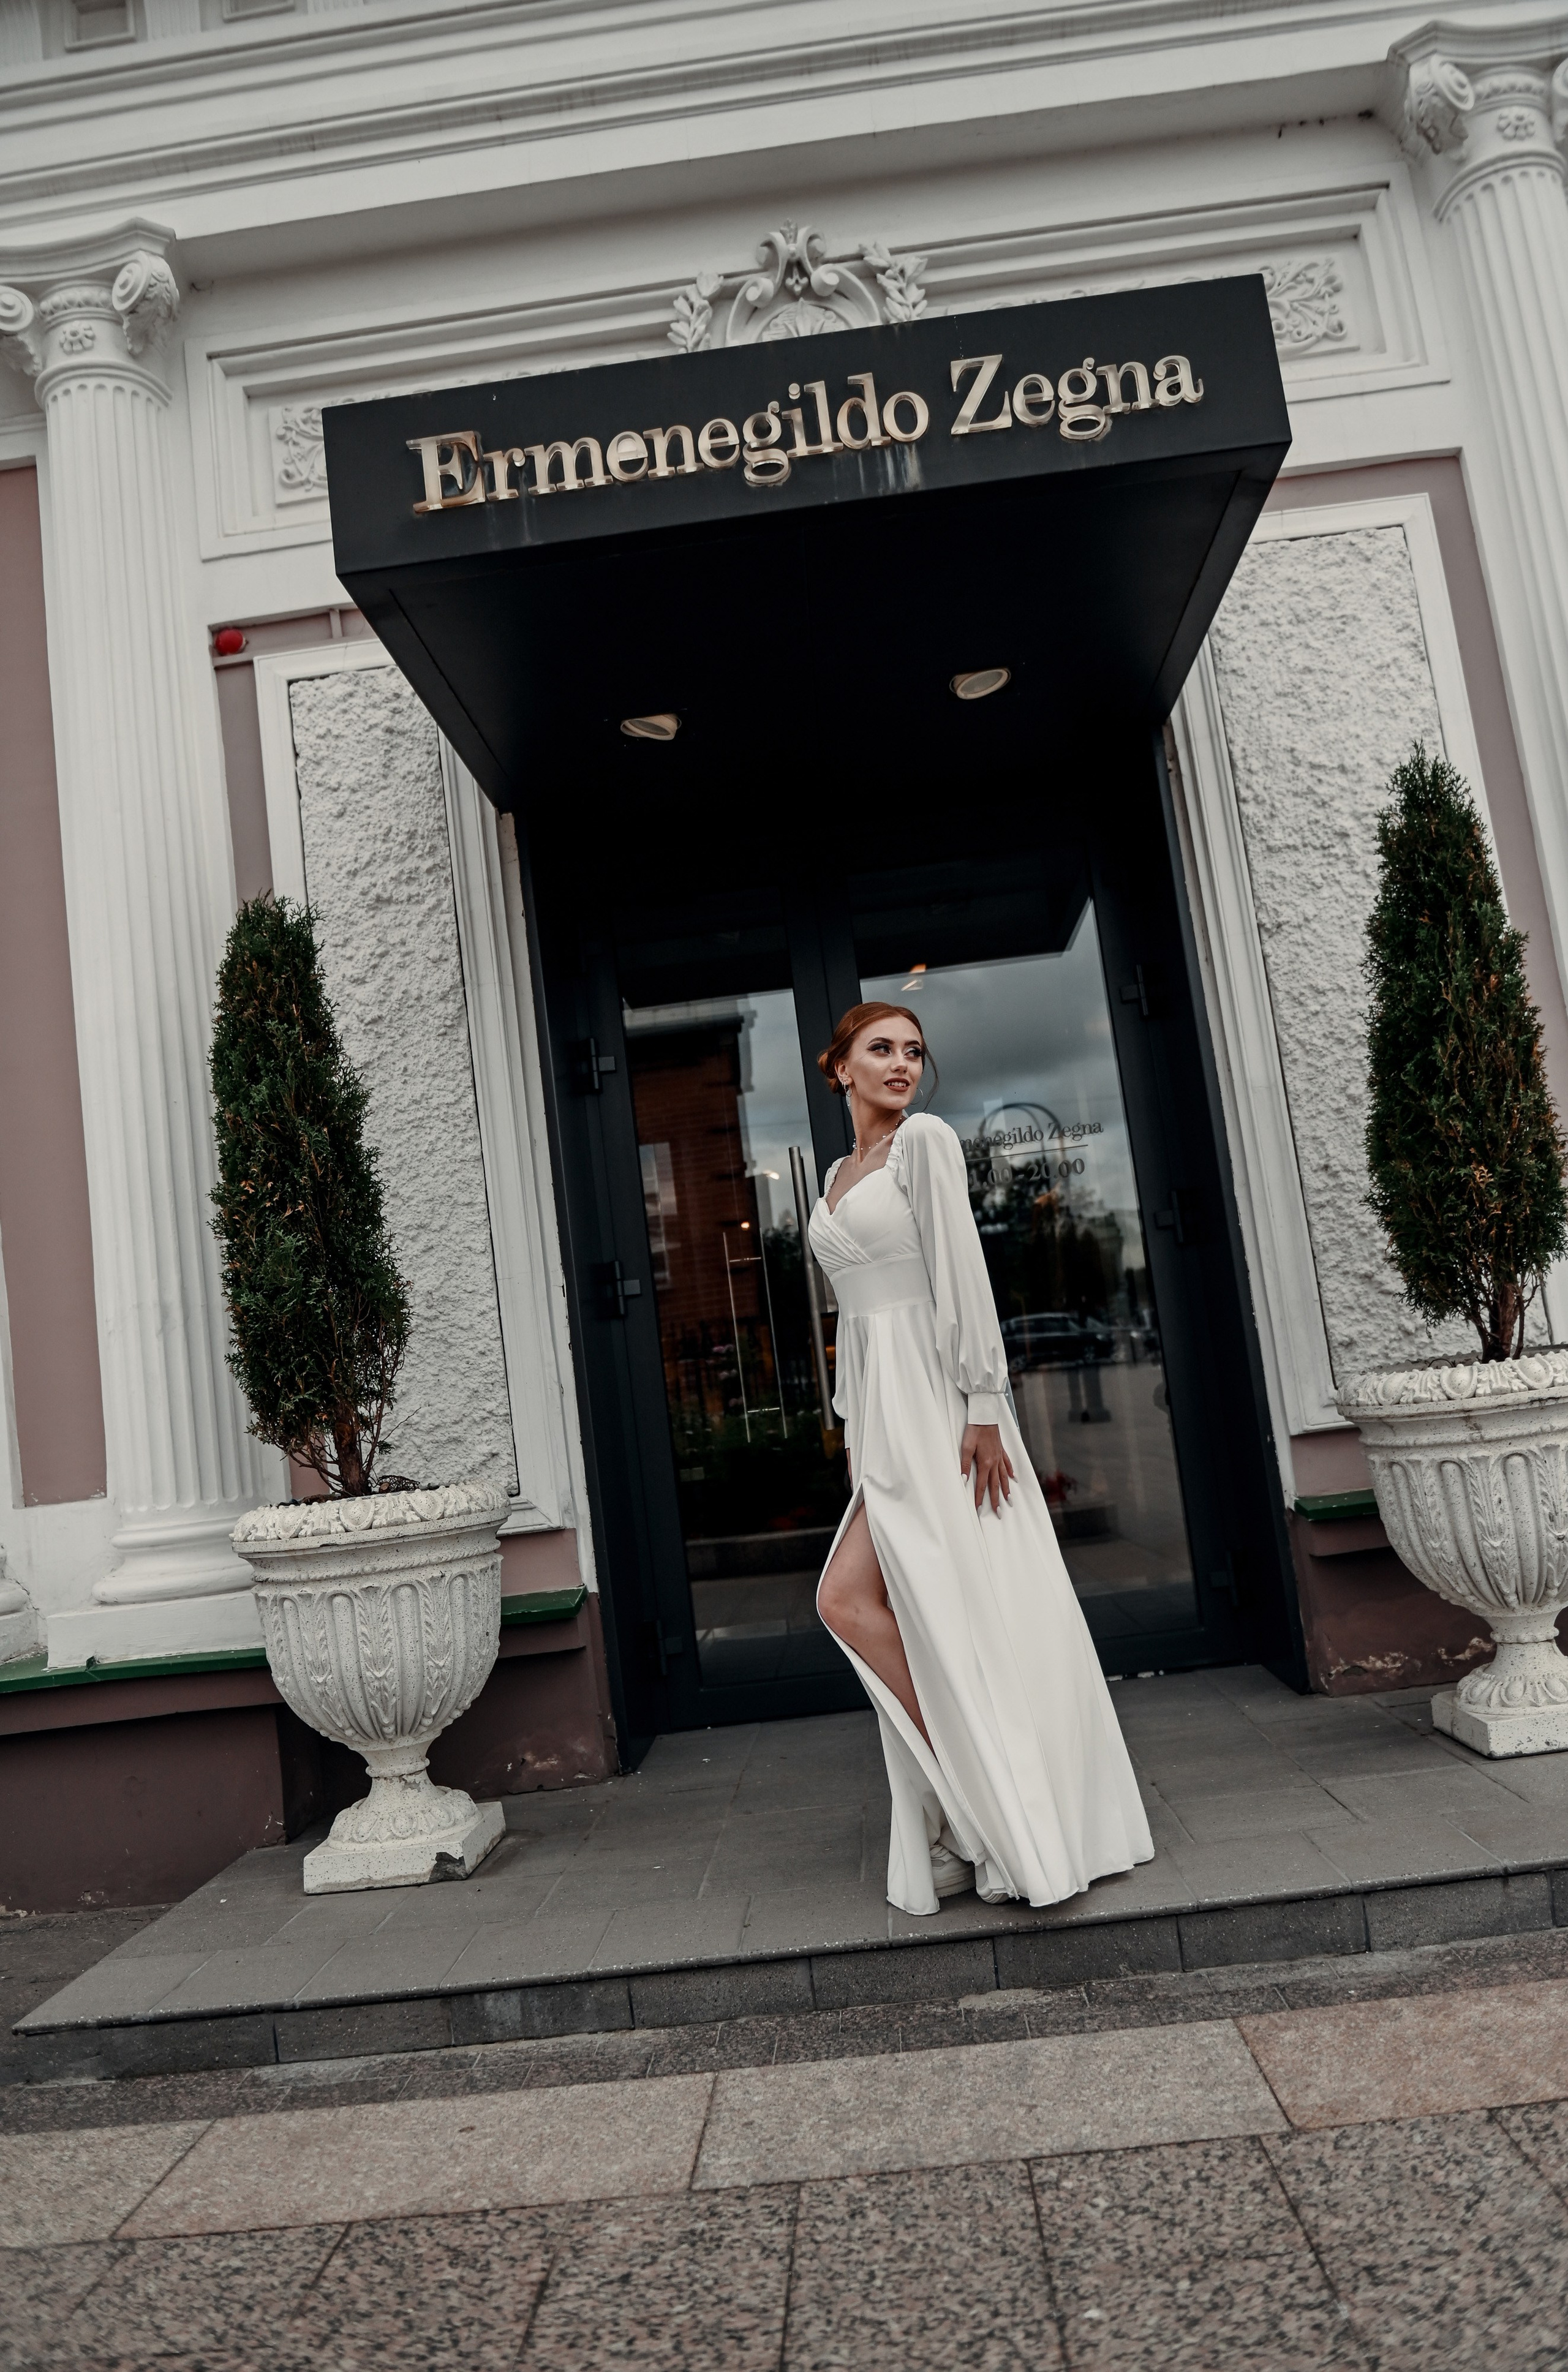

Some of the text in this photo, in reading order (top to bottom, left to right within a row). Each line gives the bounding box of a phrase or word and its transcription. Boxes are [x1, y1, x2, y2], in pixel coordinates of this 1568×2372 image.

[405, 353, 1204, 513] Ermenegildo Zegna
[960, 1121, 1104, 1150] menegildo Zegna
[968, 1167, 1012, 1189] 1.00
